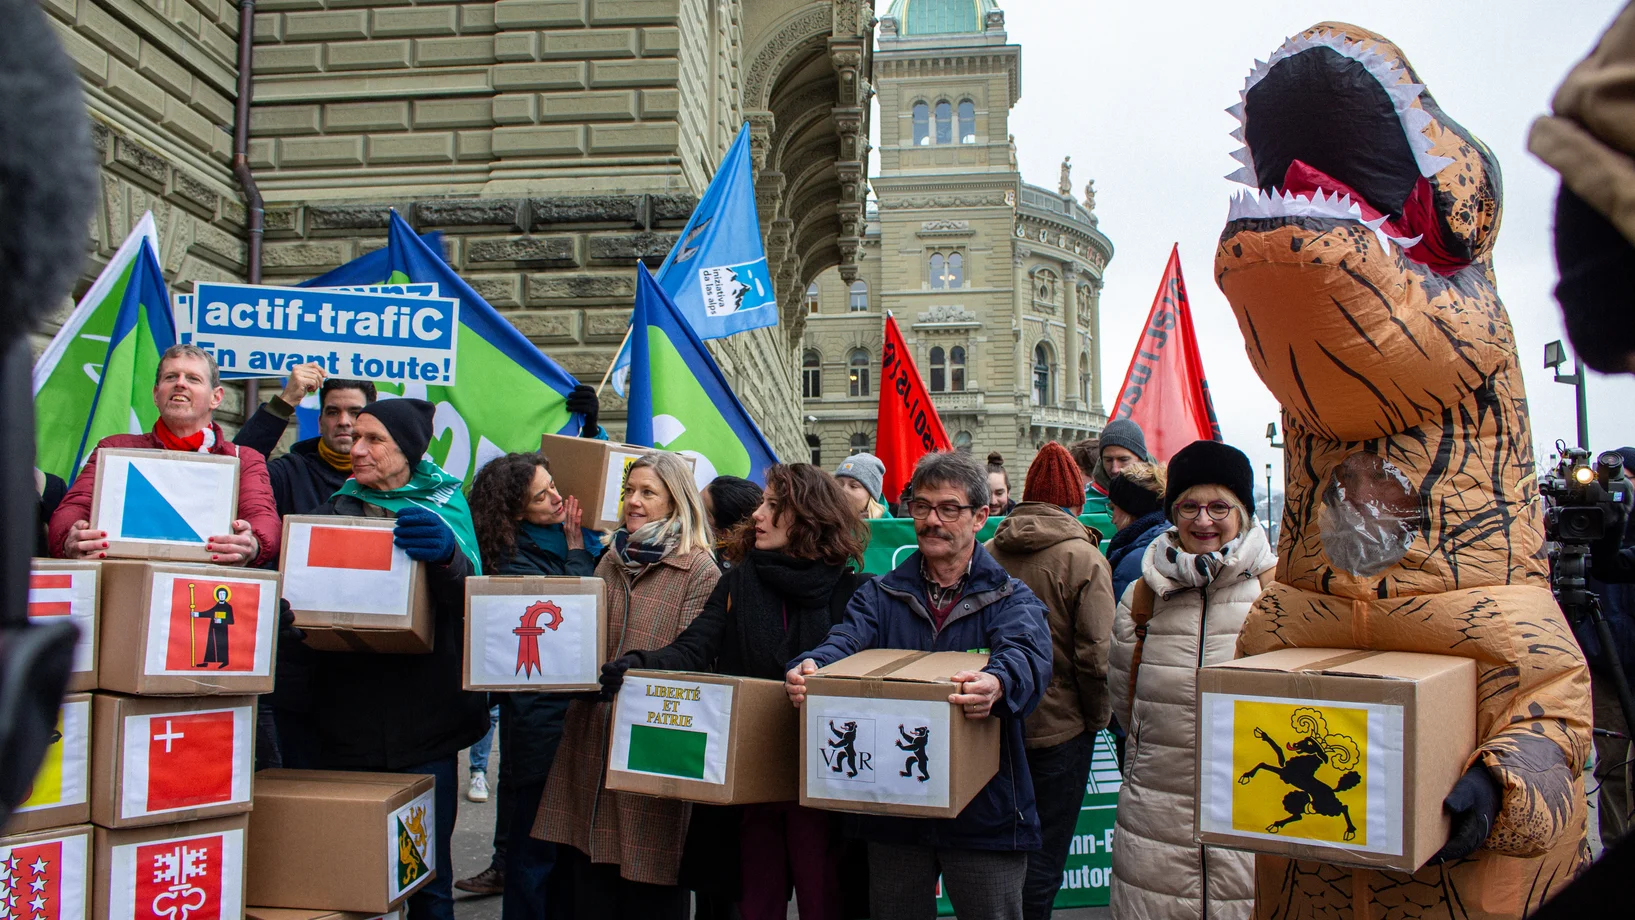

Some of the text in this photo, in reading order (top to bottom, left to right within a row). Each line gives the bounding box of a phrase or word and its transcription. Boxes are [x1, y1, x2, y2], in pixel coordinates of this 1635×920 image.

[703, 270, 717, 315] da las alps
[712, 268, 725, 308] iniziativa
[205, 298, 444, 341] actif-trafiC
[248, 350, 339, 375] avant
[351, 353, 451, 382] toute!
[645, 684, 701, 702] LIBERTÉ
[662, 700, 680, 713] ET
[646, 711, 693, 728] PATRIE
[819, 748, 874, 771] V R
